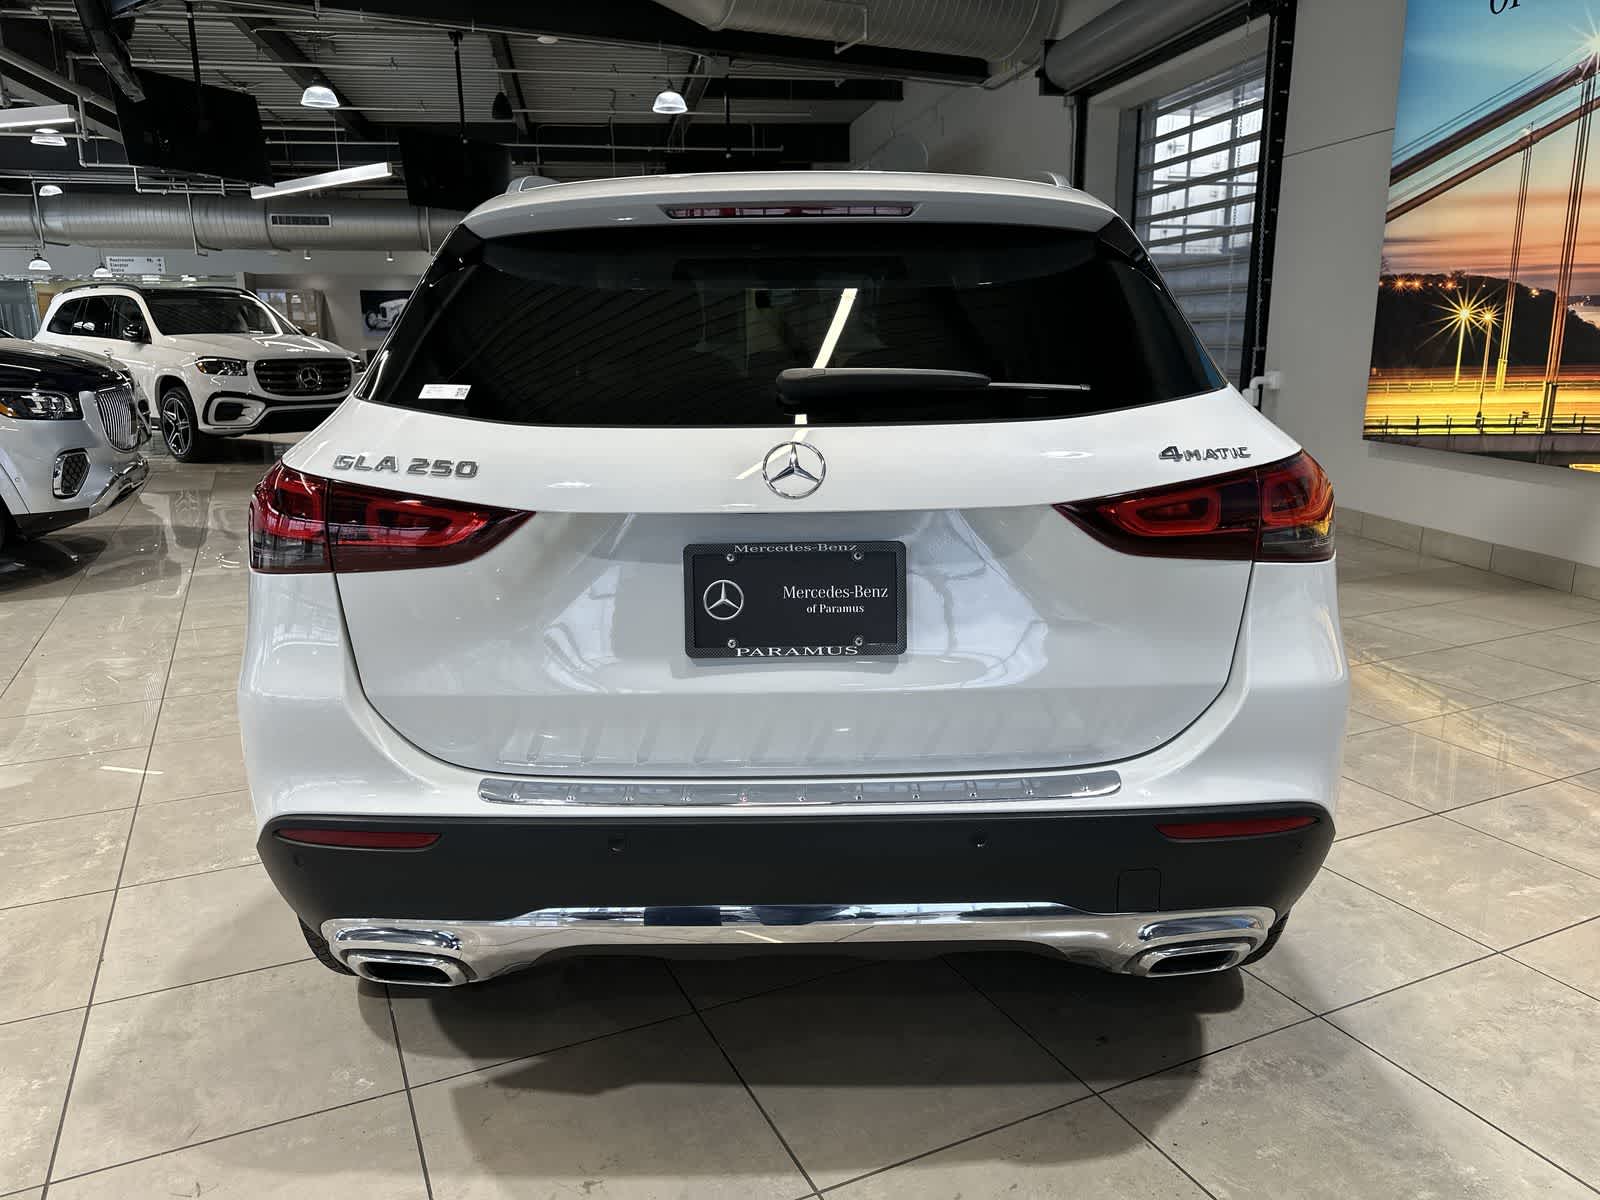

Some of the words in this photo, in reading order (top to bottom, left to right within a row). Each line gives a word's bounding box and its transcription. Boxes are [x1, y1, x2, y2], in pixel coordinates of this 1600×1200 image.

[1159, 445, 1252, 462] 4MATIC
[333, 454, 399, 472] GLA
[407, 457, 479, 478] 250
[734, 543, 859, 553] Mercedes-Benz
[783, 584, 889, 600] Mercedes-Benz
[806, 603, 818, 614] of
[819, 603, 865, 614] Paramus
[736, 645, 859, 657] PARAMUS
